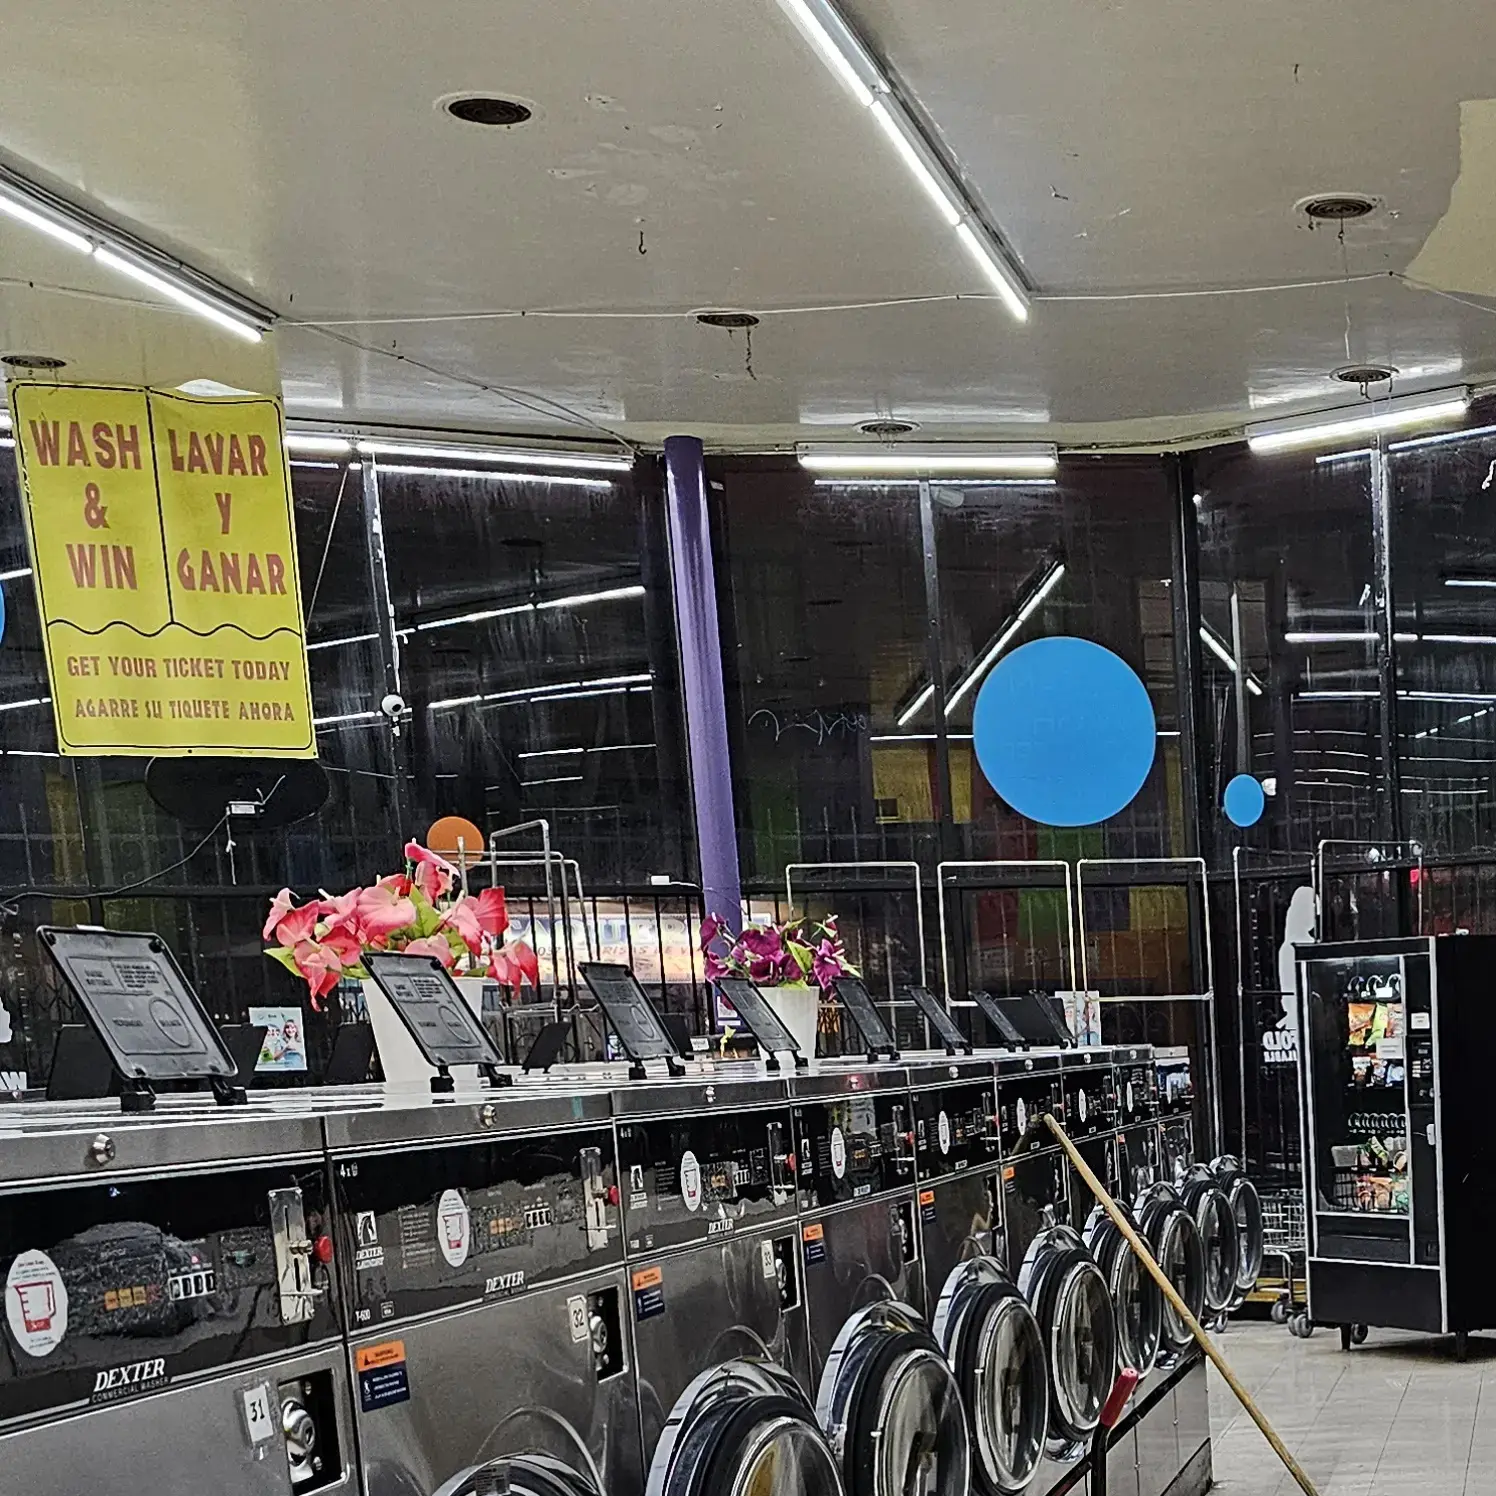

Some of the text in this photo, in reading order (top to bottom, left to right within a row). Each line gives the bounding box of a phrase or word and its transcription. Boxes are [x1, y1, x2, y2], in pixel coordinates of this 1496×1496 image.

[28, 419, 142, 471] WASH
[167, 428, 268, 477] LAVAR
[84, 482, 111, 530] &
[215, 492, 232, 535] Y
[65, 543, 138, 591] WIN
[176, 547, 288, 596] GANAR
[66, 655, 290, 682] GET YOUR TICKET TODAY
[75, 698, 295, 722] AGARRE SU TIQUETE AHORA
[485, 1271, 525, 1294] DEXTER
[572, 1306, 585, 1329] 32
[93, 1358, 166, 1393] DEXTER
[249, 1397, 266, 1423] 31
